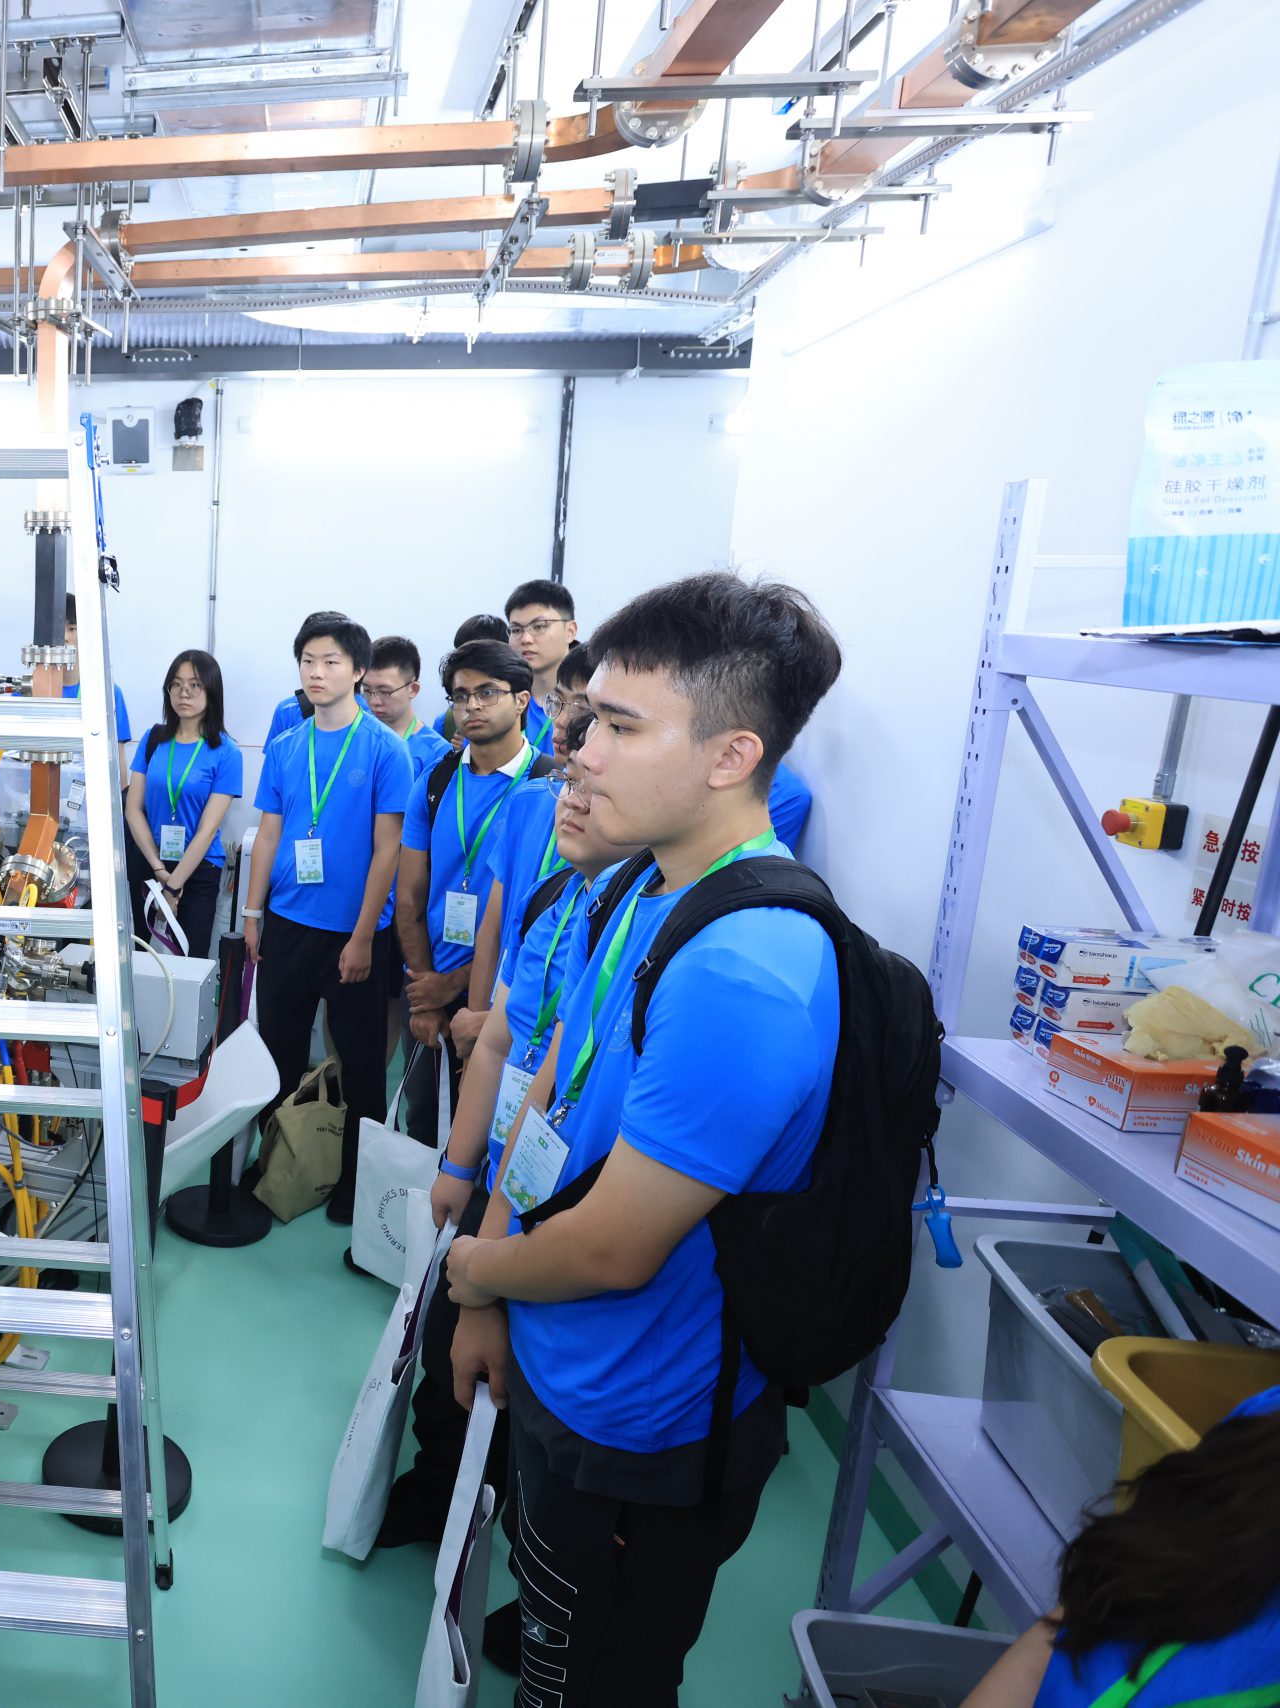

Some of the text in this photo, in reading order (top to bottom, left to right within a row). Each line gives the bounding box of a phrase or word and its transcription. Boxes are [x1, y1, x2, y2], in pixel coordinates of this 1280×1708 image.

[1173, 410, 1215, 424] 绿之源
[1165, 475, 1267, 494] 硅胶干燥剂
[1191, 888, 1252, 921] 紧时按
[1088, 950, 1119, 960] biosharp
[1092, 999, 1121, 1008] biosharp
[378, 1188, 397, 1219] PHYSICS
